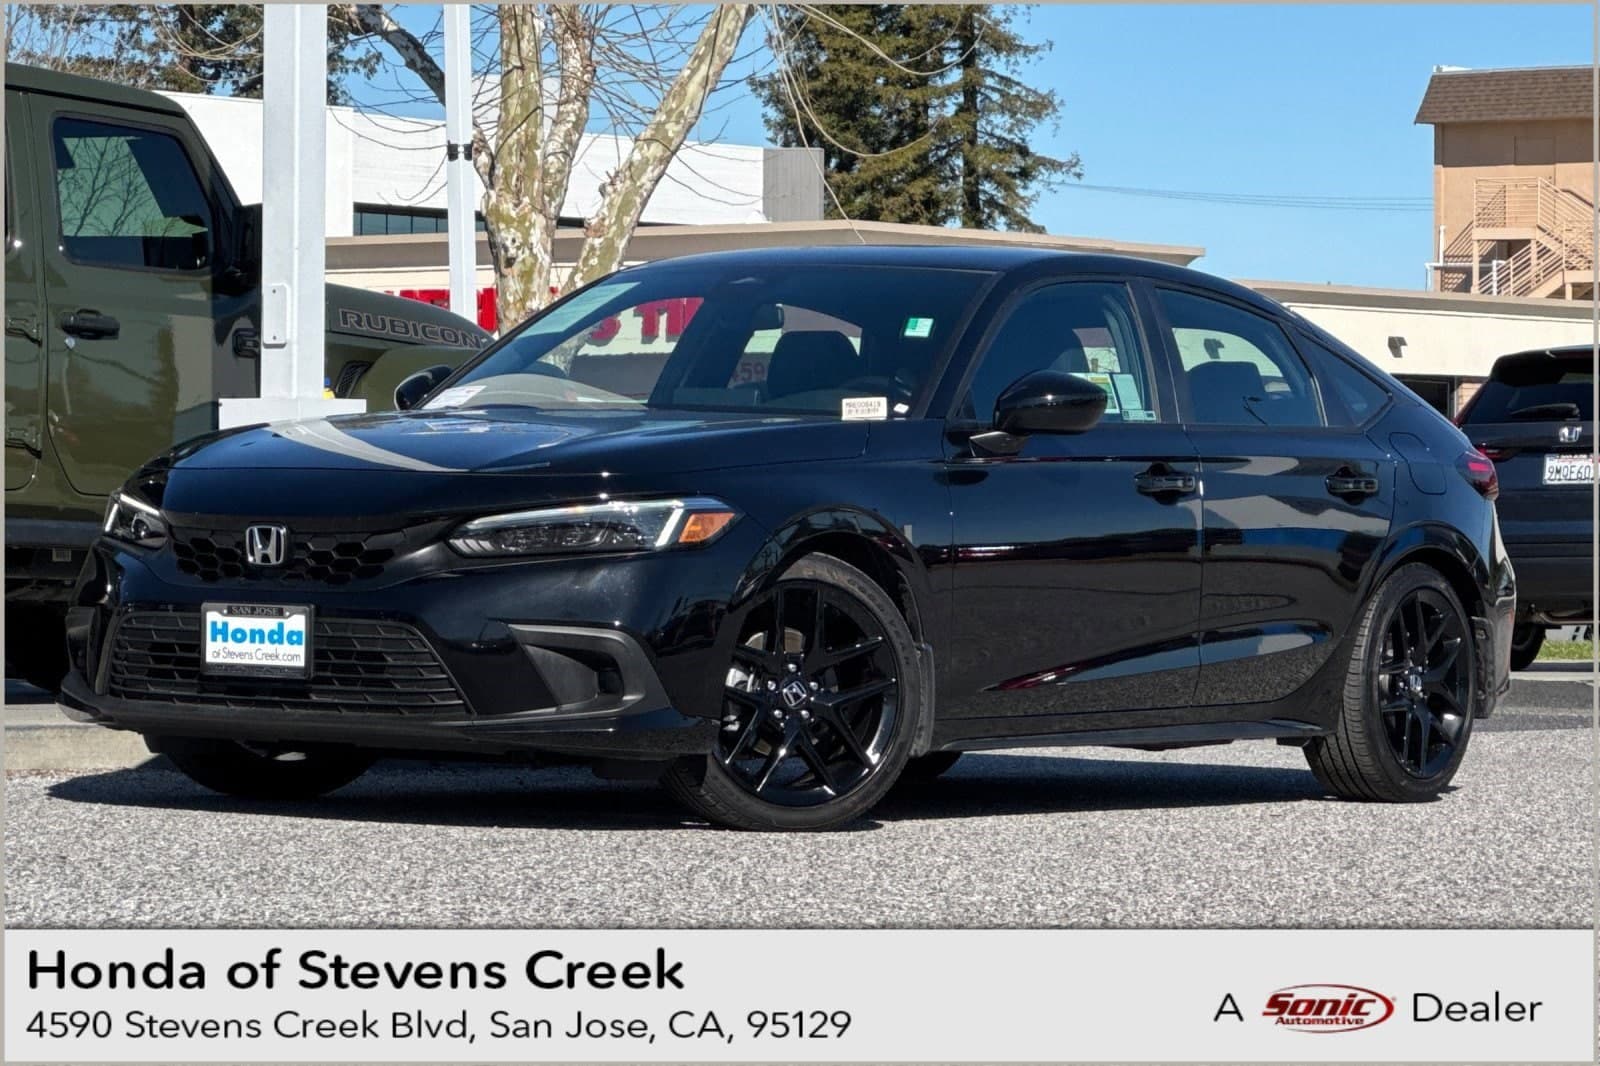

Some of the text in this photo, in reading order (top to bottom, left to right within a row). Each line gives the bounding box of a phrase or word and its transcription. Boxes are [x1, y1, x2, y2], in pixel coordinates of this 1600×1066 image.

[338, 308, 483, 350] RUBICON
[231, 605, 279, 616] SAN JOSE
[210, 620, 304, 646] Honda
[212, 646, 302, 662] of Stevens Creek.com
